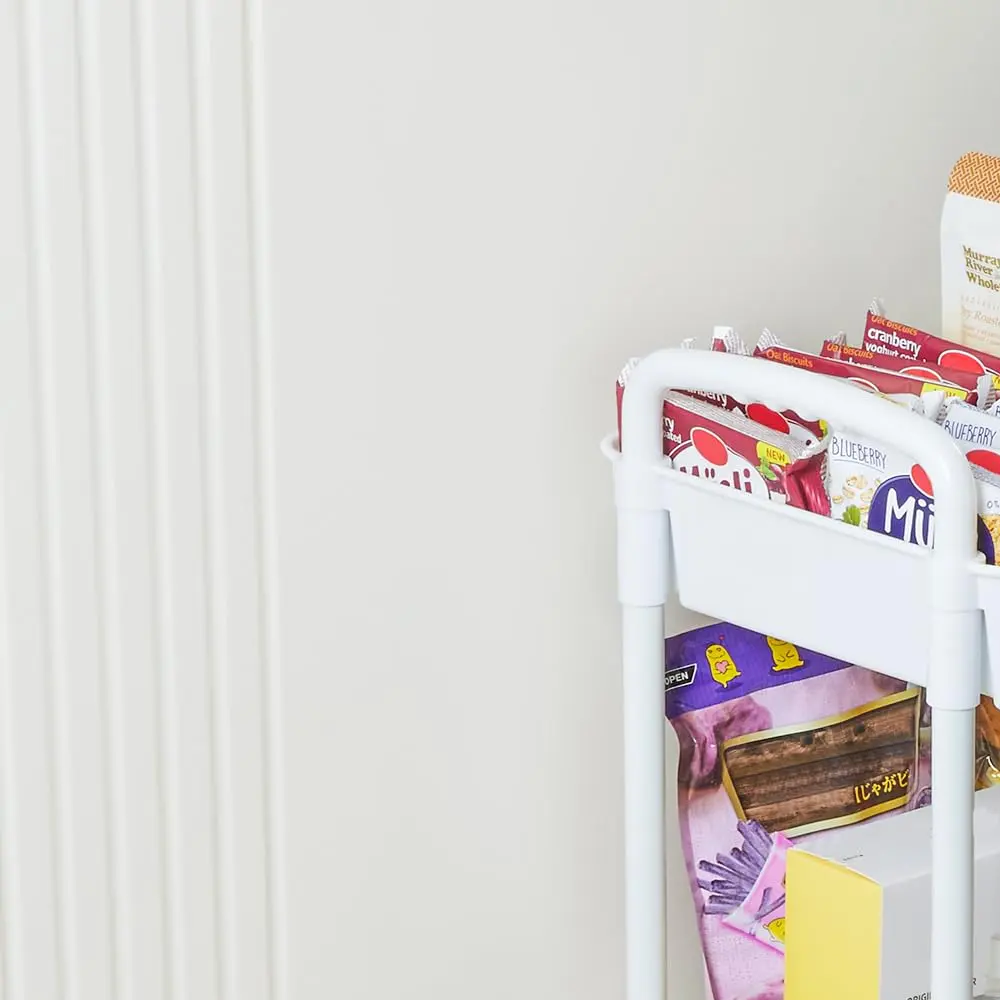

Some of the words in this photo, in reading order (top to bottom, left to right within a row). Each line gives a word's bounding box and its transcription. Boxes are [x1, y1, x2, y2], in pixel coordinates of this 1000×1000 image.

[965, 257, 993, 275] River
[867, 328, 922, 357] cranberry
[766, 447, 785, 462] NEW
[832, 436, 887, 470] BLUEBERRY
